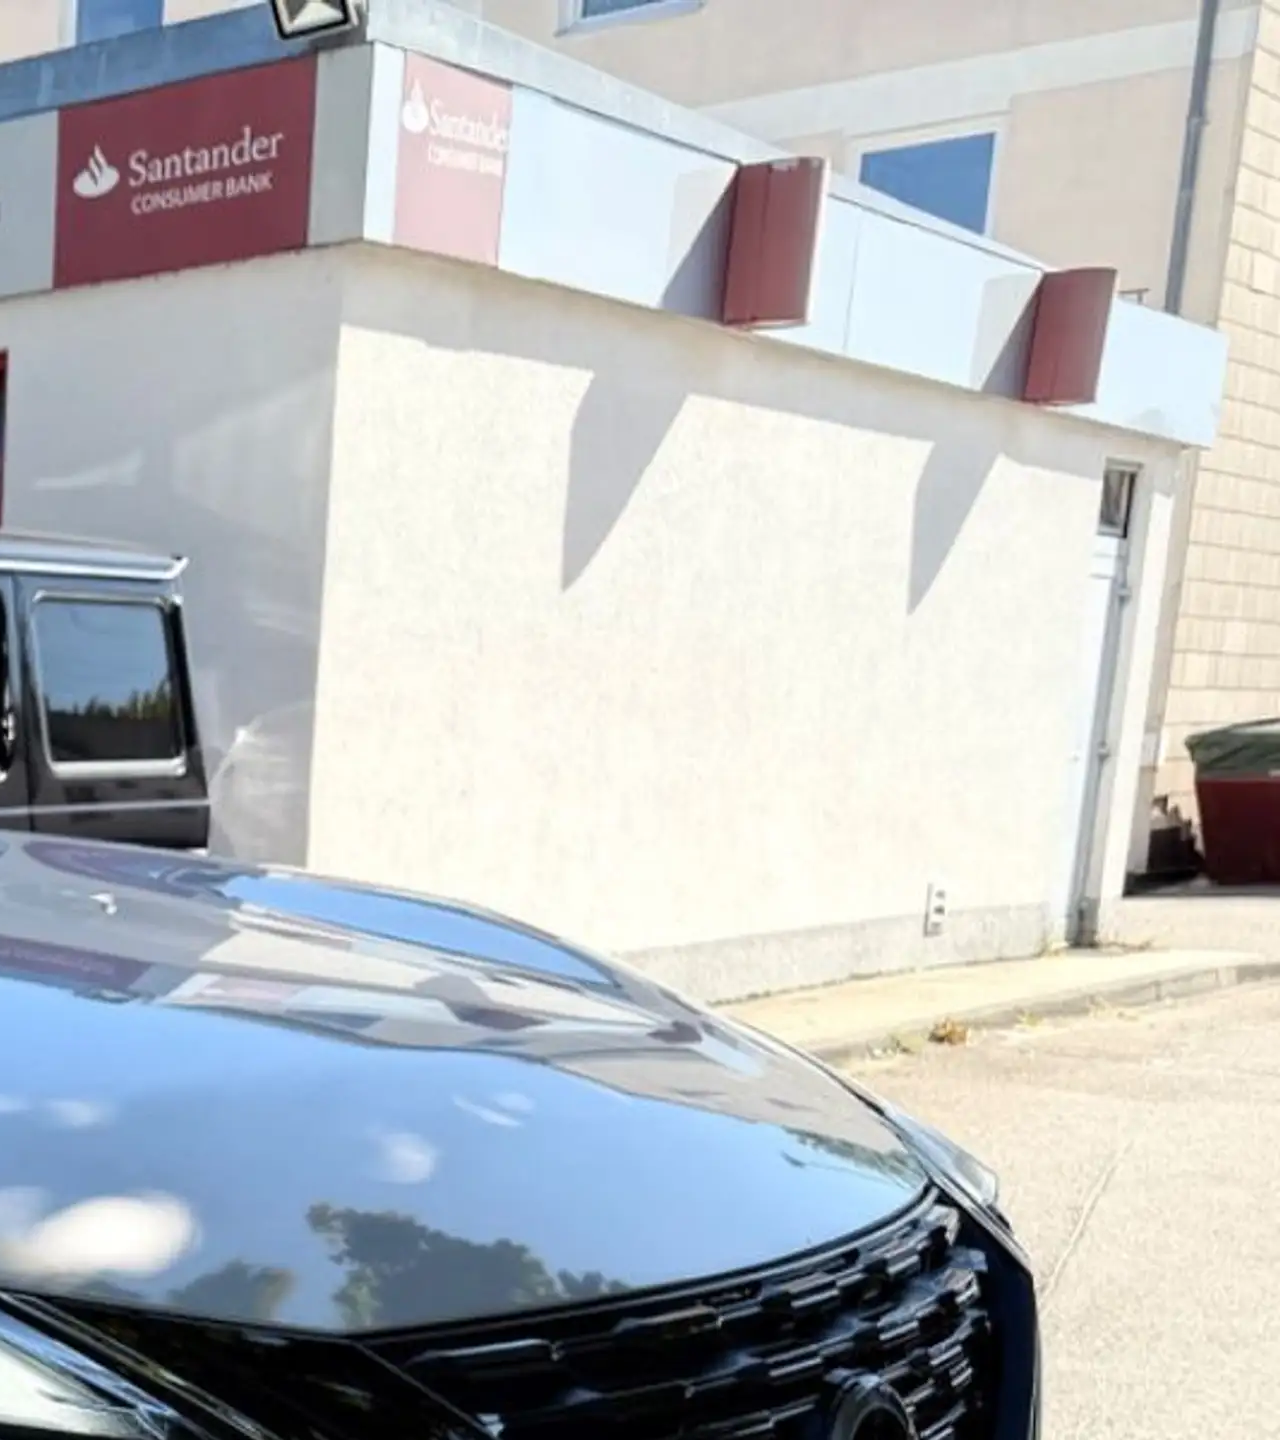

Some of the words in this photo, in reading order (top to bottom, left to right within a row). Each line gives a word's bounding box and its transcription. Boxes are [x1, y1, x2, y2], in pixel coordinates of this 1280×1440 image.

[428, 98, 508, 153] Santande
[128, 124, 284, 187] Santander
[130, 180, 224, 215] CONSUMER
[226, 170, 274, 198] BANK
